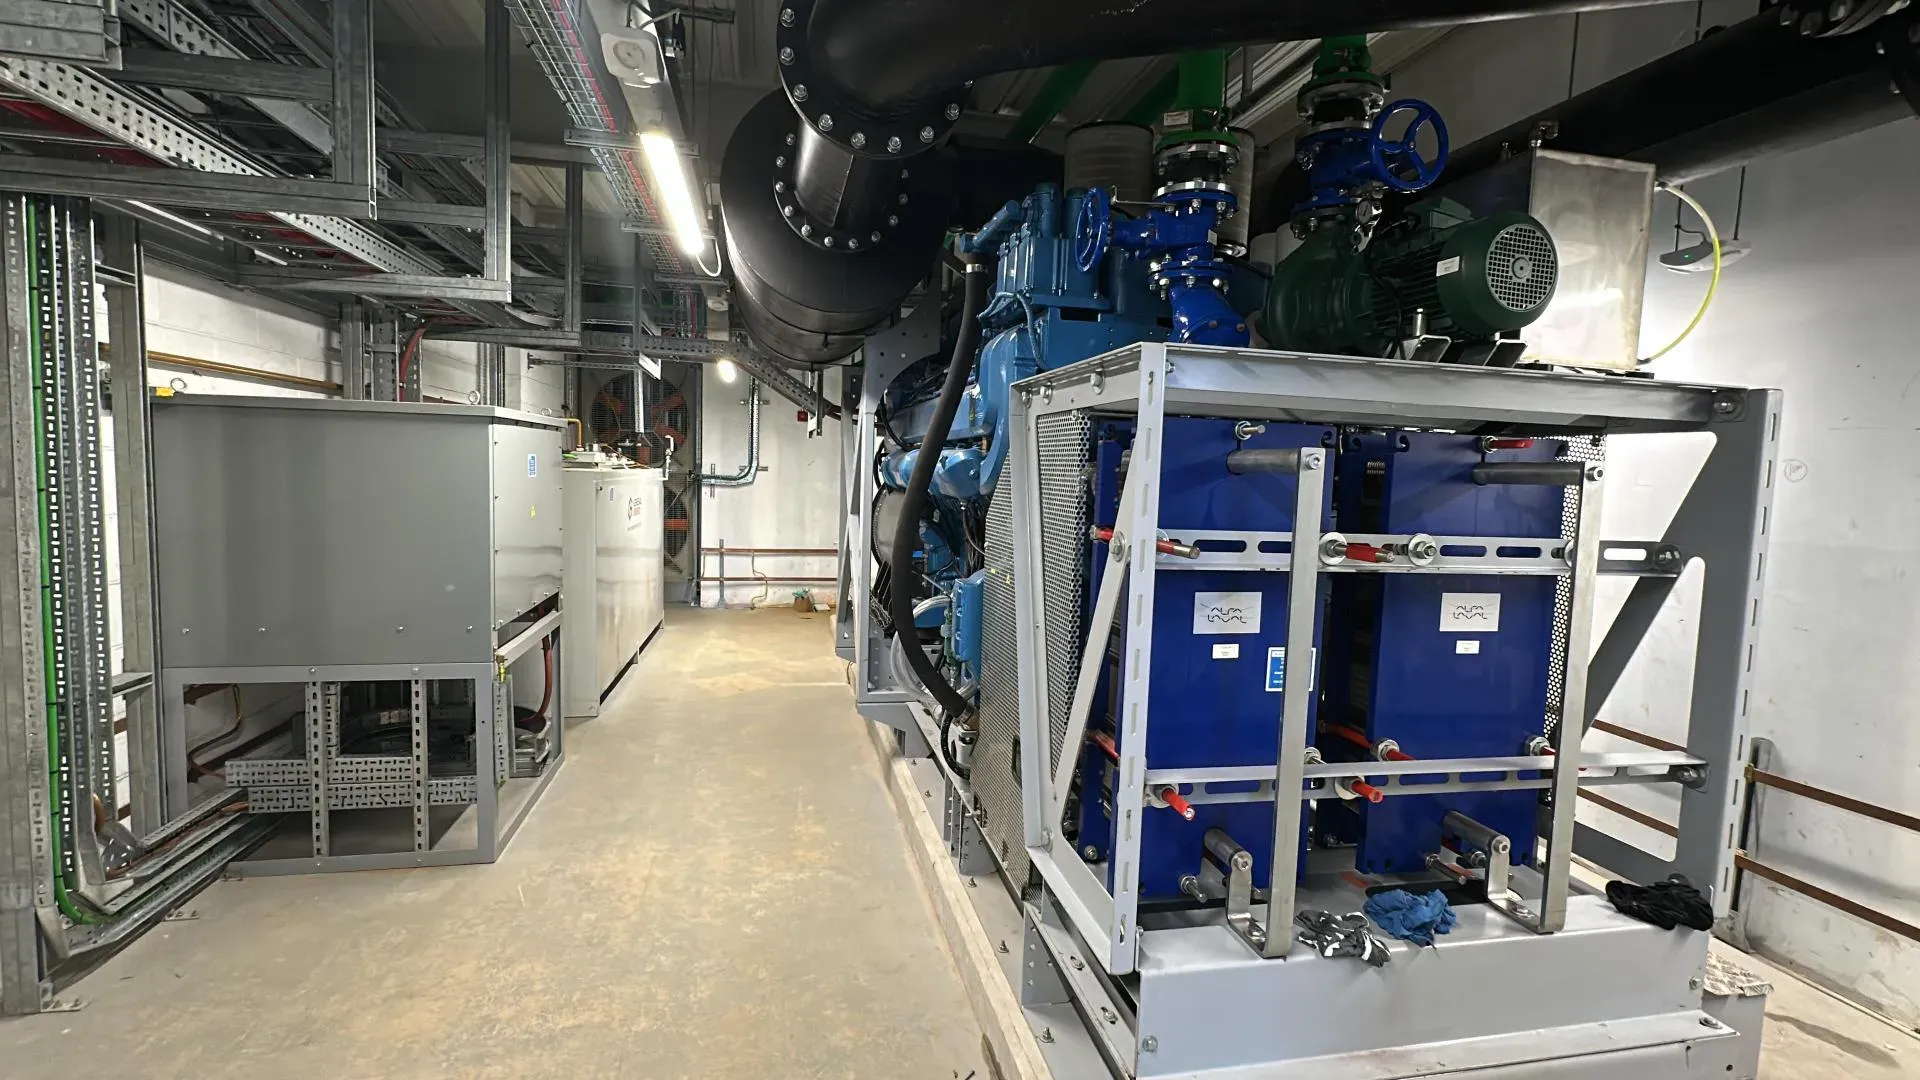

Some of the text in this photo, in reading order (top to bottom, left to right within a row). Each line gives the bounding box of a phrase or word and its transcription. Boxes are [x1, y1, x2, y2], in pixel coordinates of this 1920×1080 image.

[1211, 607, 1241, 615] ALFA
[1454, 611, 1487, 619] LAVAL
[1208, 615, 1246, 623] LAVAL
